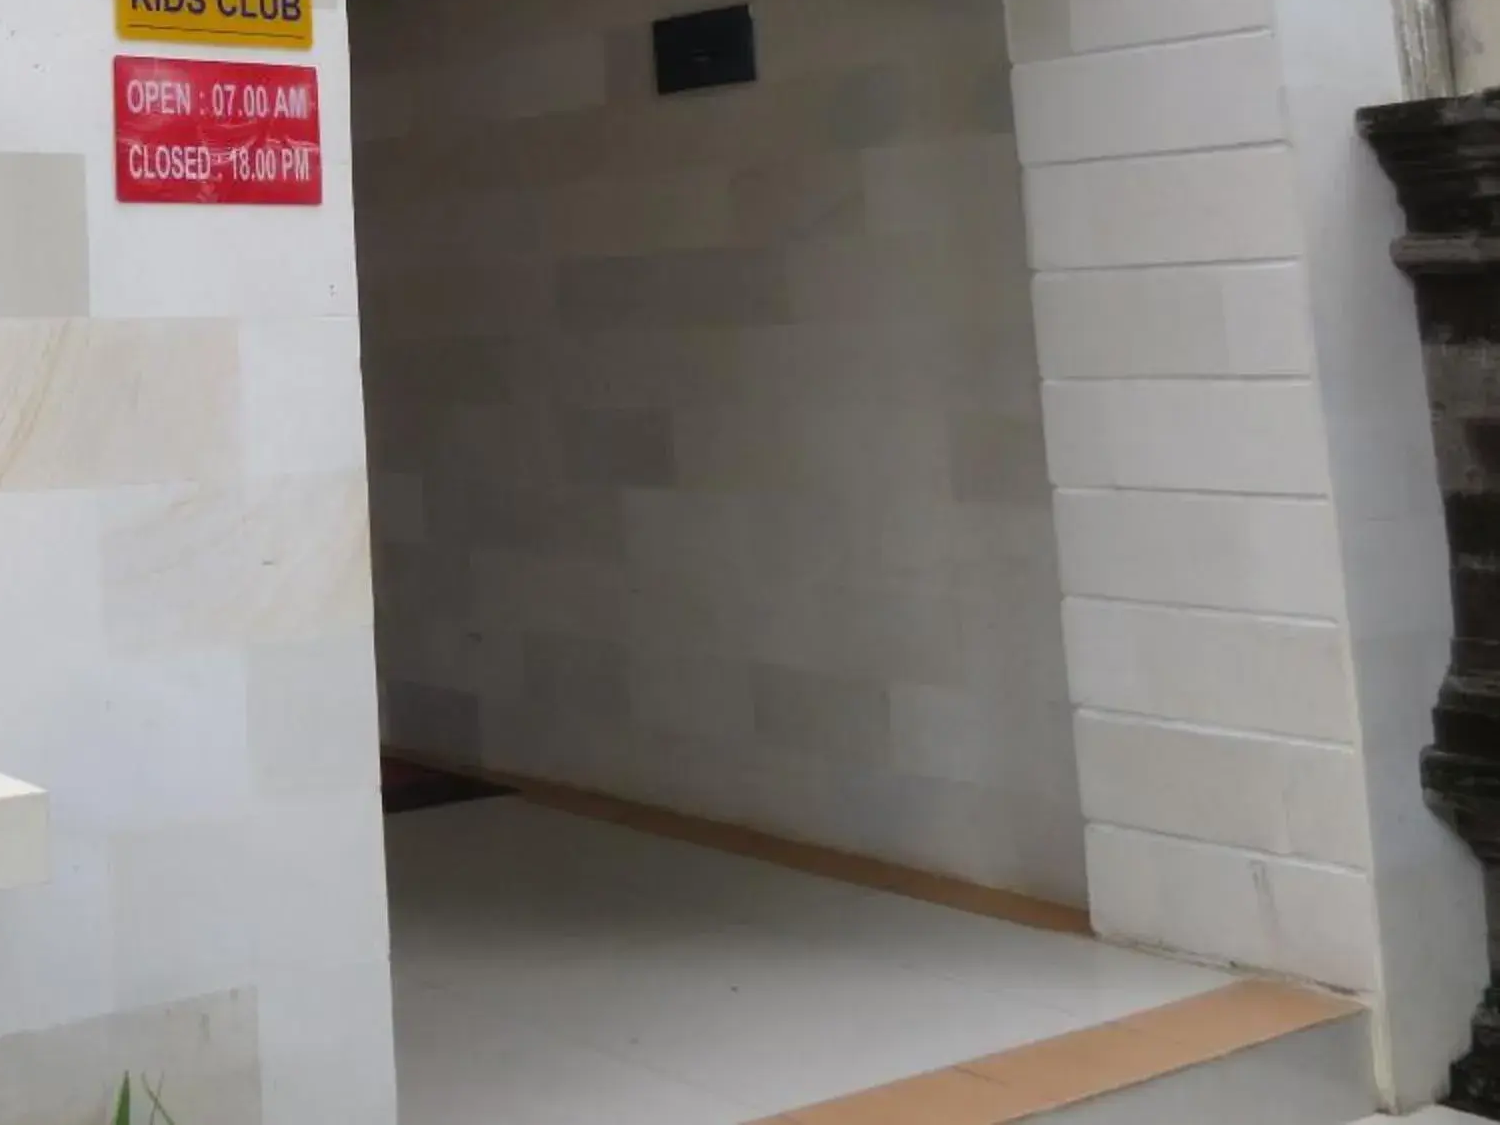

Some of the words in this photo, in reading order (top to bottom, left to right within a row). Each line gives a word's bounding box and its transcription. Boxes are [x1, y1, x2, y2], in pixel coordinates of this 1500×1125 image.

[127, 80, 190, 115] OPEN
[212, 85, 269, 118] 07.00
[274, 87, 308, 120] AM
[129, 144, 210, 180] CLOSED
[229, 147, 275, 181] 18.00
[282, 149, 309, 181] PM
